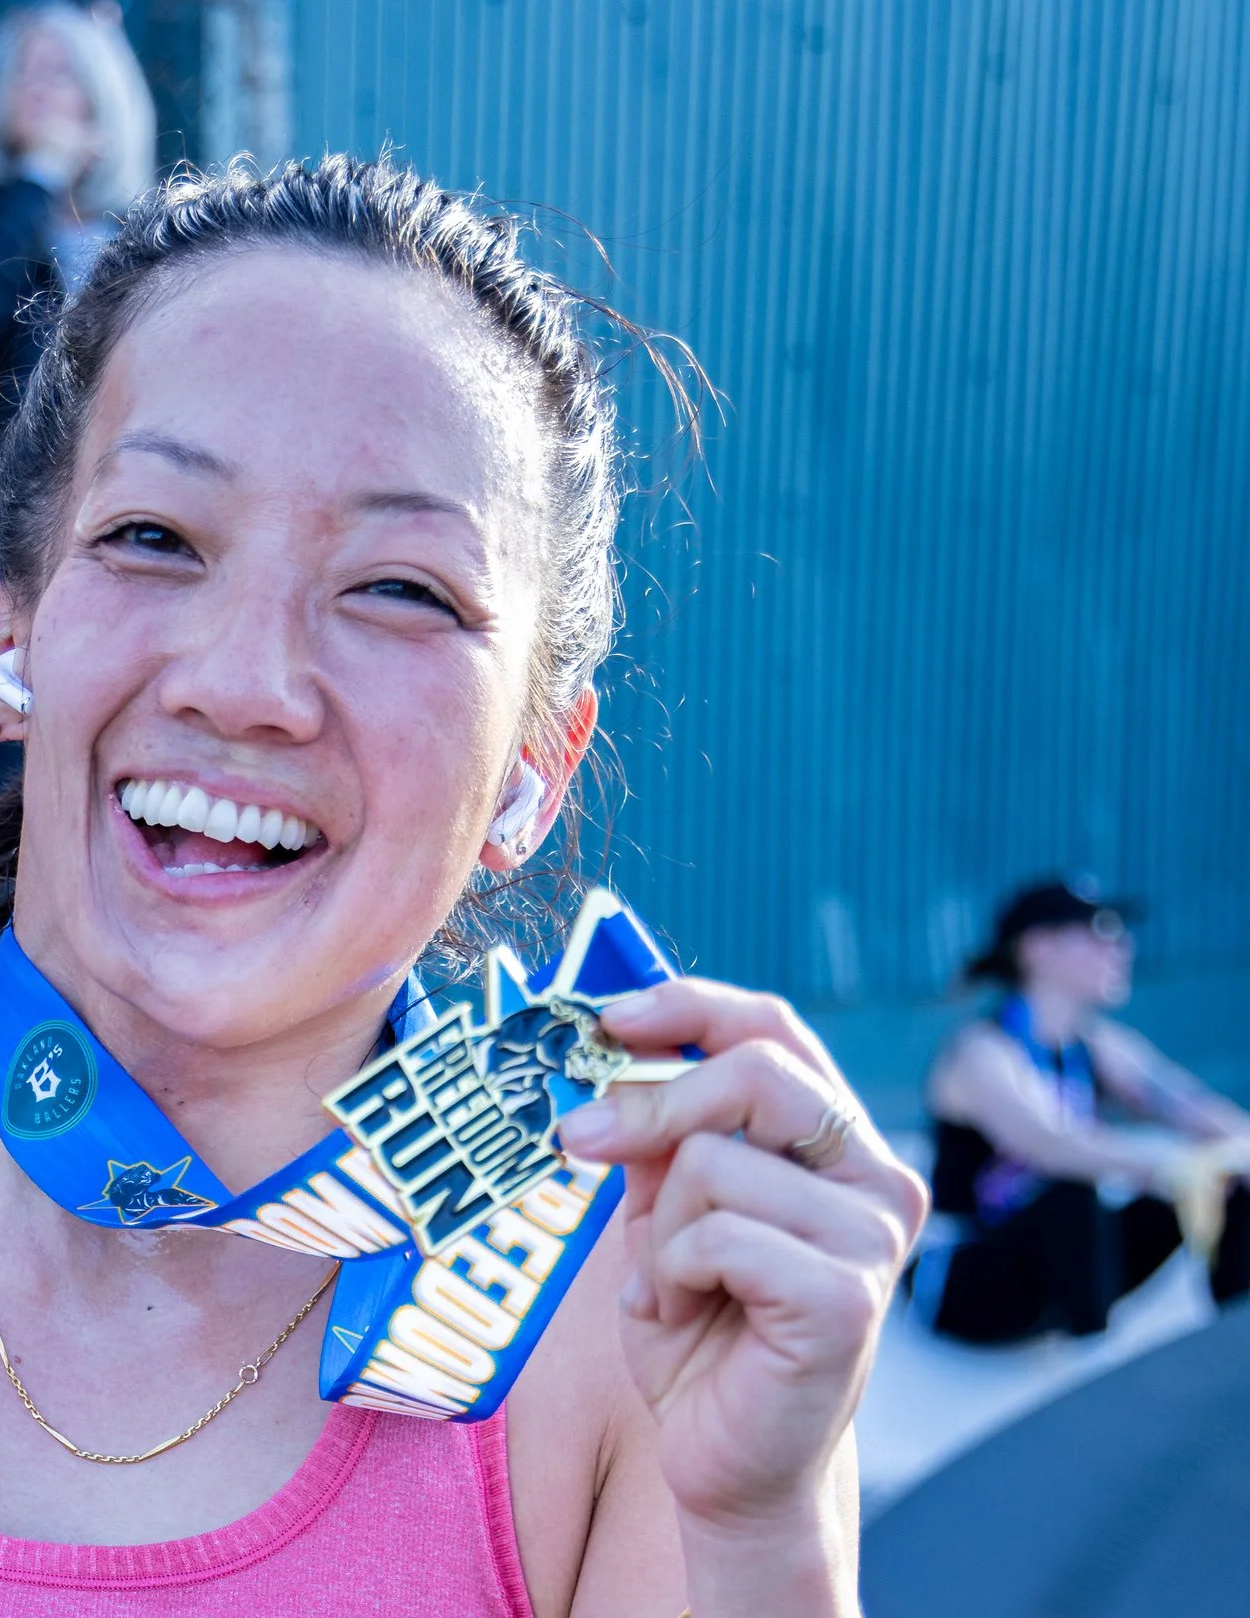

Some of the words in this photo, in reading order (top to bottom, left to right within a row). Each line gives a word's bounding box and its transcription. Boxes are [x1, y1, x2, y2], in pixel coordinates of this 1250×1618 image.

[14, 1036, 53, 1090] OAKLAND
[34, 1077, 82, 1124] BALLERS
[405, 1015, 561, 1198] FREEDOM
[334, 1059, 497, 1247] RUN
